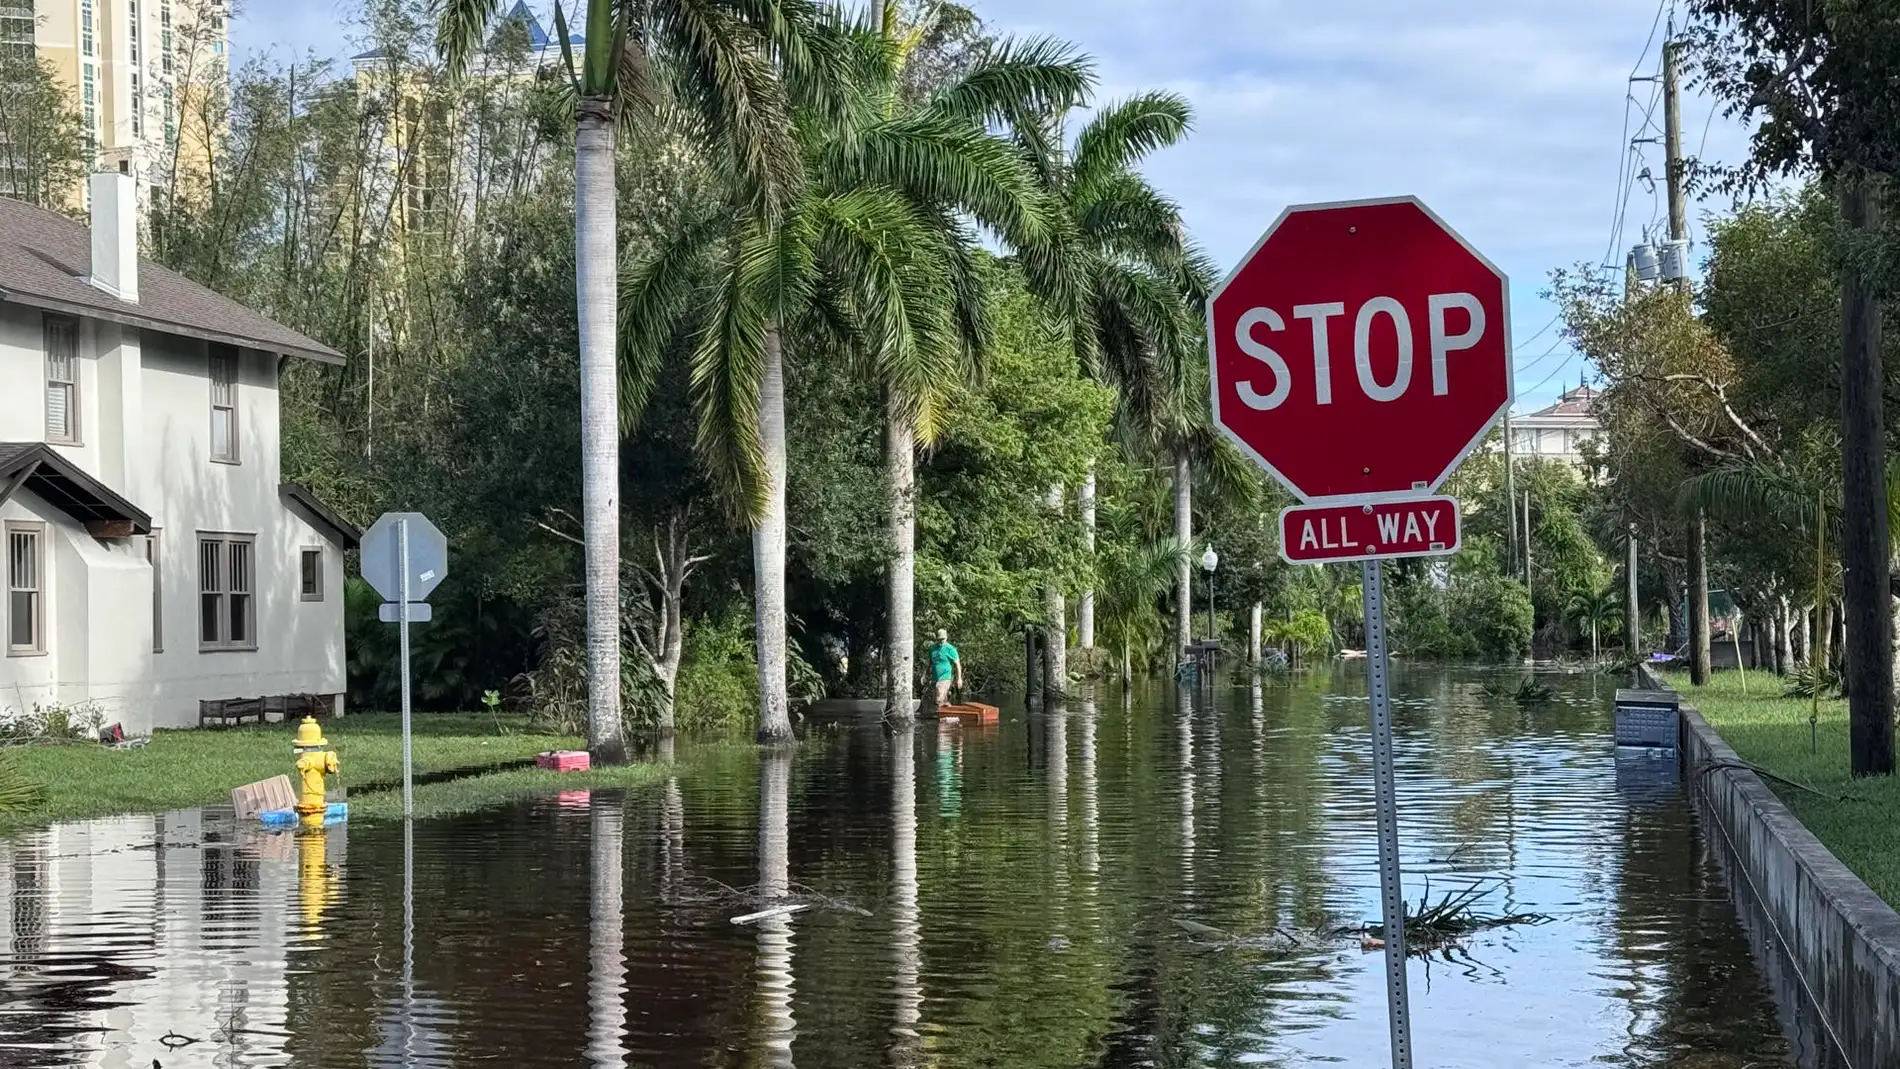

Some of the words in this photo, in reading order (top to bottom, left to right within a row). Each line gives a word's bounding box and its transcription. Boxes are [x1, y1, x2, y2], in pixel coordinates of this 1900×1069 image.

[1234, 292, 1486, 411] STOP
[1300, 516, 1358, 550] ALL
[1376, 510, 1440, 544] WAY
